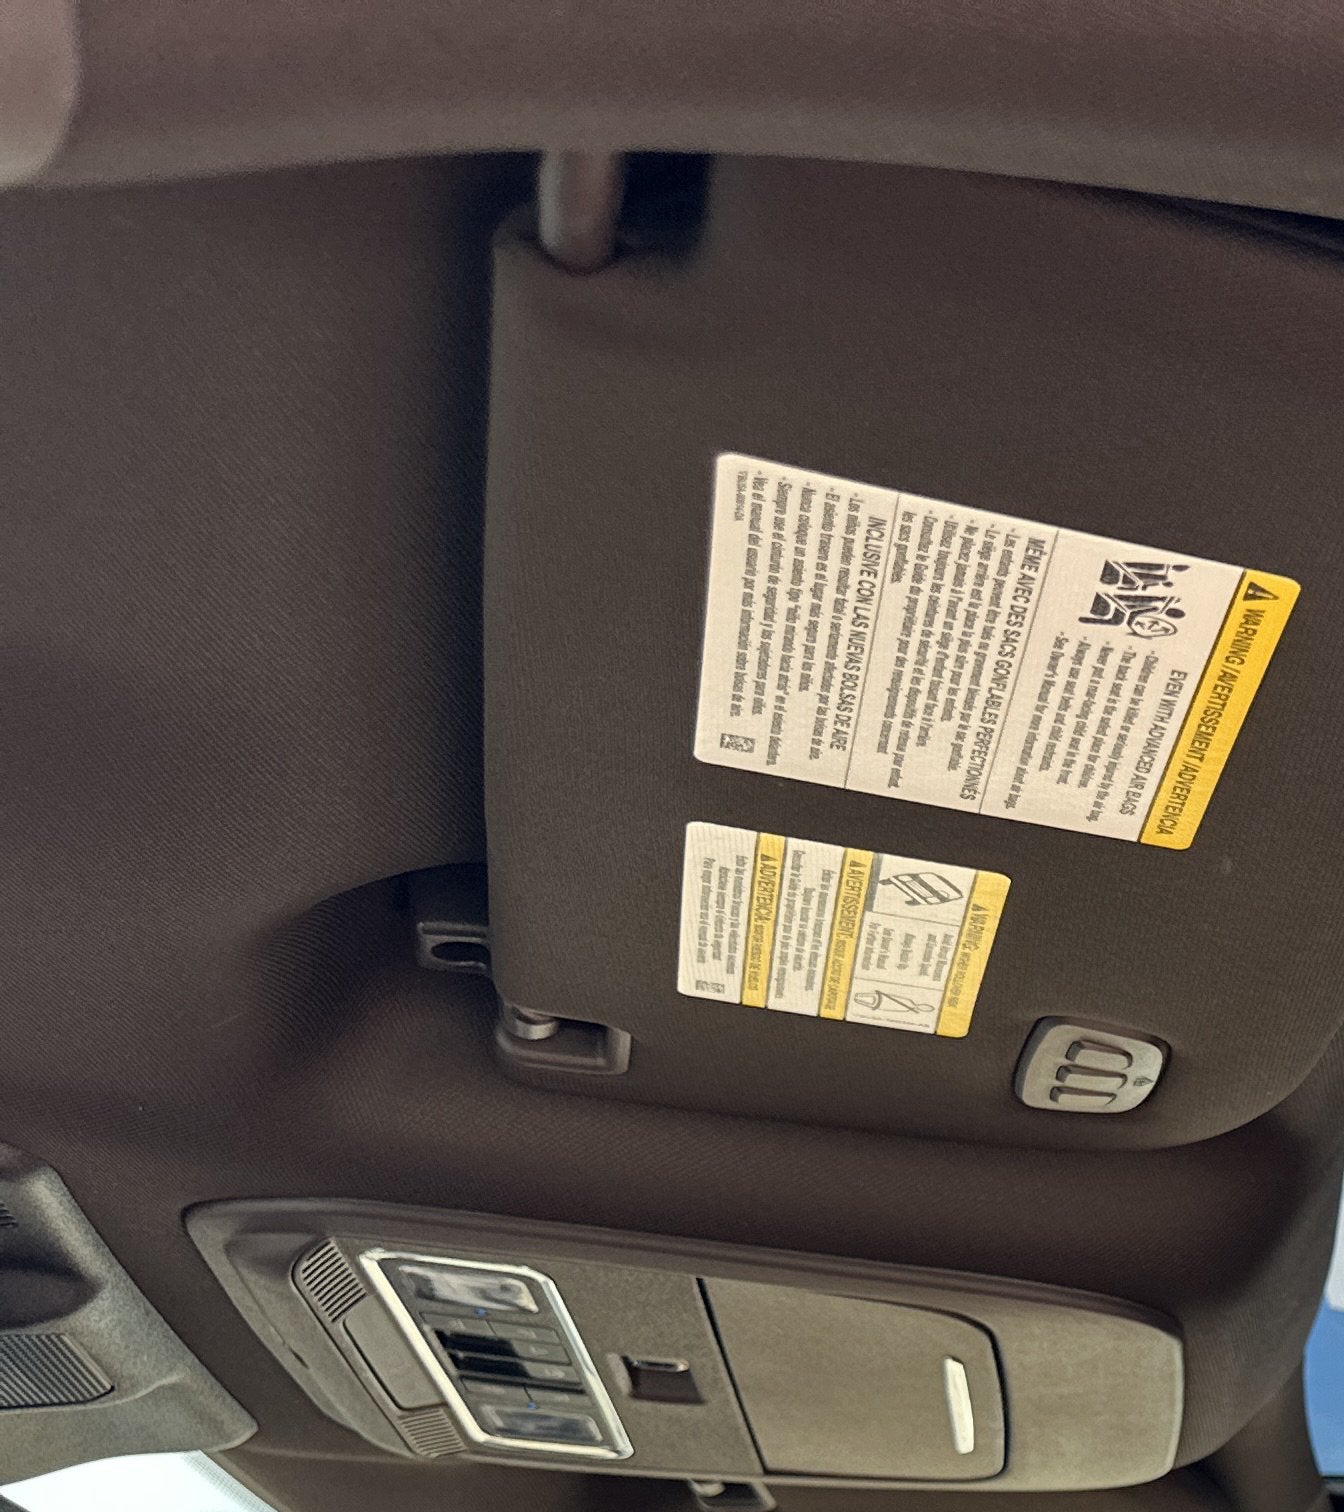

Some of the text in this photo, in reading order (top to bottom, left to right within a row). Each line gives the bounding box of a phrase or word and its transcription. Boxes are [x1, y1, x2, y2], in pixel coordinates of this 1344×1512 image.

[829, 515, 888, 752] INCLUSIVE CON LAS NUEVAS BOLSAS DE AIRE
[958, 537, 1048, 801] MÊME AVEC DES SACS GONFLABLES PERFECTIONNÉS
[1118, 669, 1189, 816] EVEN WITH ADVANCED AIR BAGS
[1155, 608, 1266, 835] WARNING /AVERTISSEMENT /ADVERTENCIA
